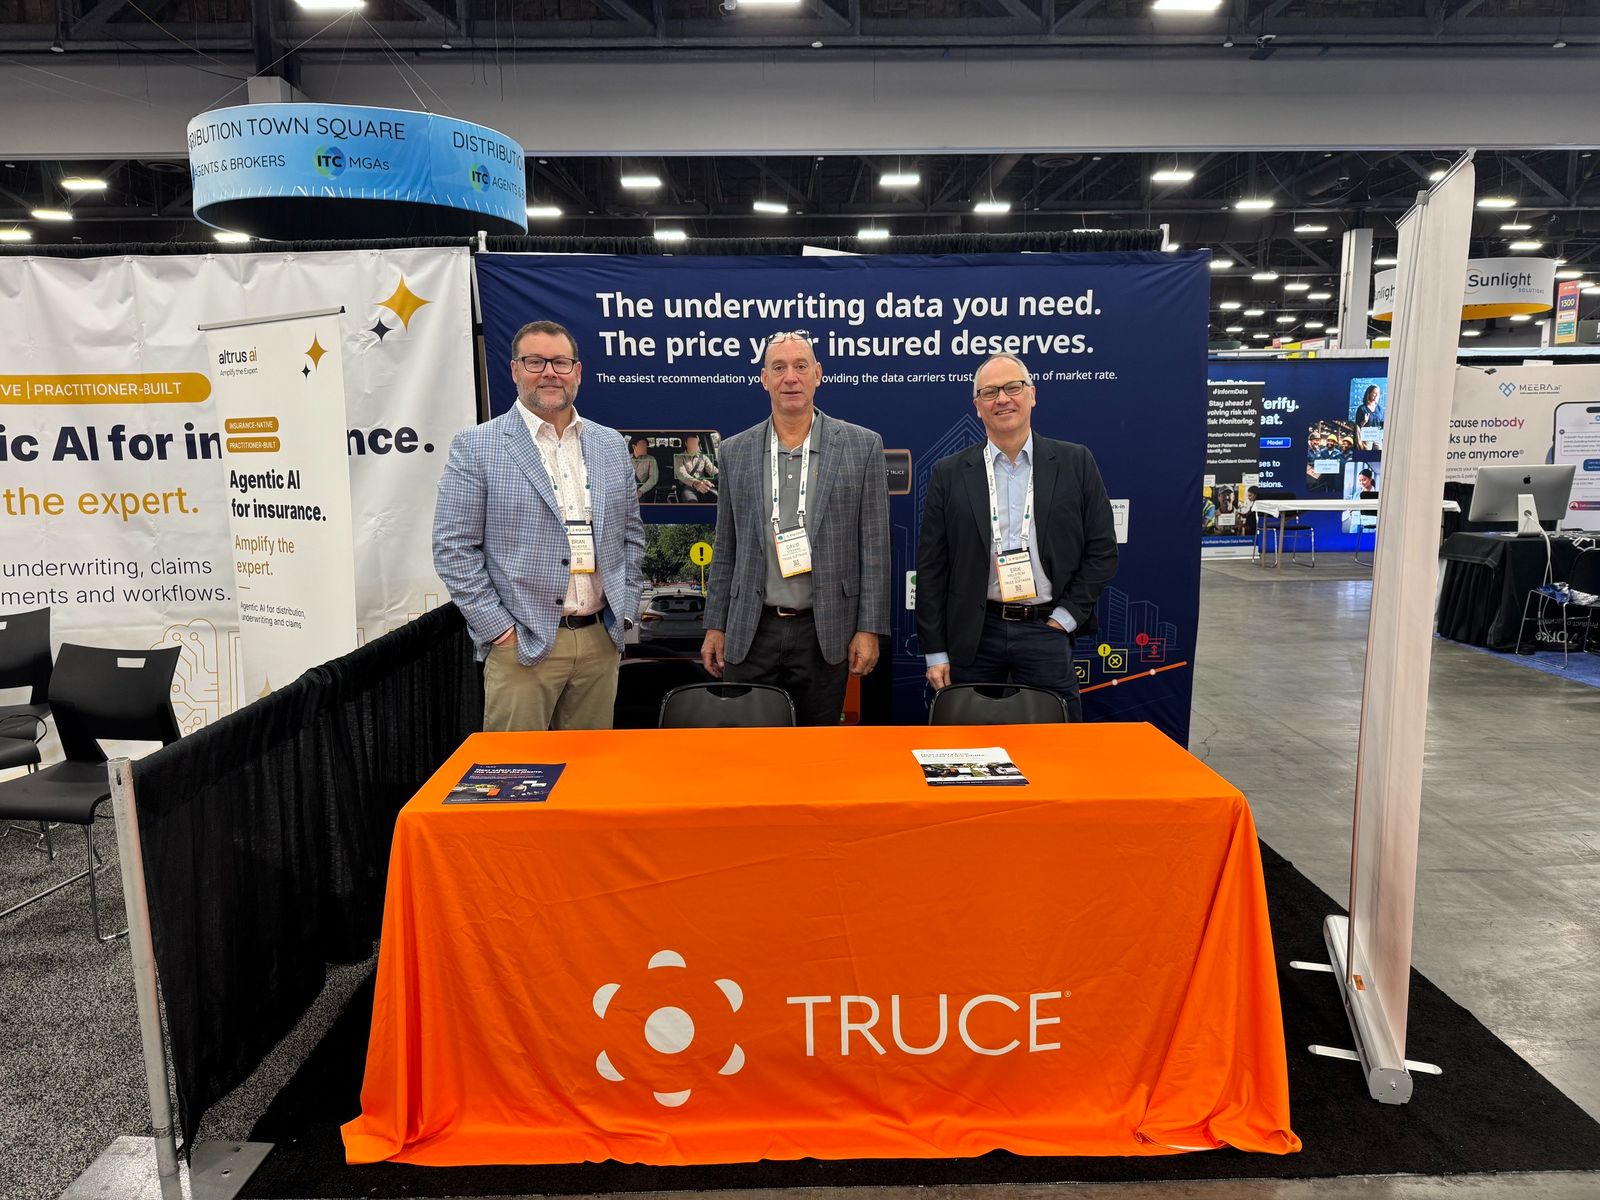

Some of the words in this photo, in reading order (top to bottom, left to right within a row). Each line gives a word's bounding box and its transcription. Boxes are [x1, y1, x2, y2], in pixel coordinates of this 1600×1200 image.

[247, 118, 309, 136] TOWN
[316, 118, 406, 140] SQUARE
[221, 160, 228, 171] &
[230, 155, 286, 170] BROKERS
[318, 155, 342, 168] ITC
[349, 157, 389, 171] MGAs
[472, 170, 488, 184] ITC
[1468, 272, 1532, 289] Sunlight
[596, 292, 654, 318] The
[664, 290, 865, 326] underwriting
[876, 292, 943, 318] data
[952, 296, 1008, 324] you
[1019, 289, 1101, 316] need.
[598, 330, 656, 356] The
[667, 330, 740, 364] price
[749, 337, 819, 364] yr
[829, 329, 940, 357] insured
[951, 329, 1093, 355] deserves.
[219, 348, 247, 364] altrus
[249, 347, 257, 362] ai
[596, 373, 616, 383] The
[619, 373, 654, 383] easiest
[657, 373, 745, 383] recommendation
[748, 376, 762, 385] yo
[862, 372, 878, 383] the
[881, 372, 904, 382] data
[907, 372, 946, 382] carriers
[948, 371, 975, 384] trust,
[1042, 370, 1053, 380] of
[1056, 370, 1091, 380] market
[1094, 371, 1118, 380] rate.
[0, 384, 21, 396] VE
[34, 382, 182, 397] PRACTITIONER-BUILT
[1209, 400, 1224, 408] Stay
[1262, 397, 1300, 412] erify.
[230, 421, 273, 429] INSURANCE-NATIVE
[1219, 418, 1255, 426] Monitoring.
[1481, 417, 1524, 429] nobody
[0, 424, 39, 462] ic
[52, 426, 100, 461] AI
[108, 424, 174, 461] for
[230, 441, 276, 449] PRACTITIONER-BUILT
[1463, 436, 1476, 446] up
[1480, 433, 1497, 443] the
[230, 469, 284, 493] Agentic
[288, 470, 300, 490] AI
[3, 487, 64, 515] the
[78, 488, 199, 522] expert.
[232, 498, 250, 518] for
[254, 498, 327, 522] insurance.
[235, 534, 275, 555] Amplify
[278, 537, 295, 554] the
[3, 558, 144, 578] underwriting,
[151, 558, 212, 575] claims
[237, 560, 273, 577] expert.
[1, 588, 68, 605] ments
[76, 586, 115, 603] and
[123, 584, 231, 602] workflows.
[240, 601, 258, 613] Agentic
[259, 603, 266, 612] AI
[266, 603, 275, 613] for
[276, 603, 306, 619] distribution,
[274, 616, 284, 626] and
[286, 618, 302, 629] claims
